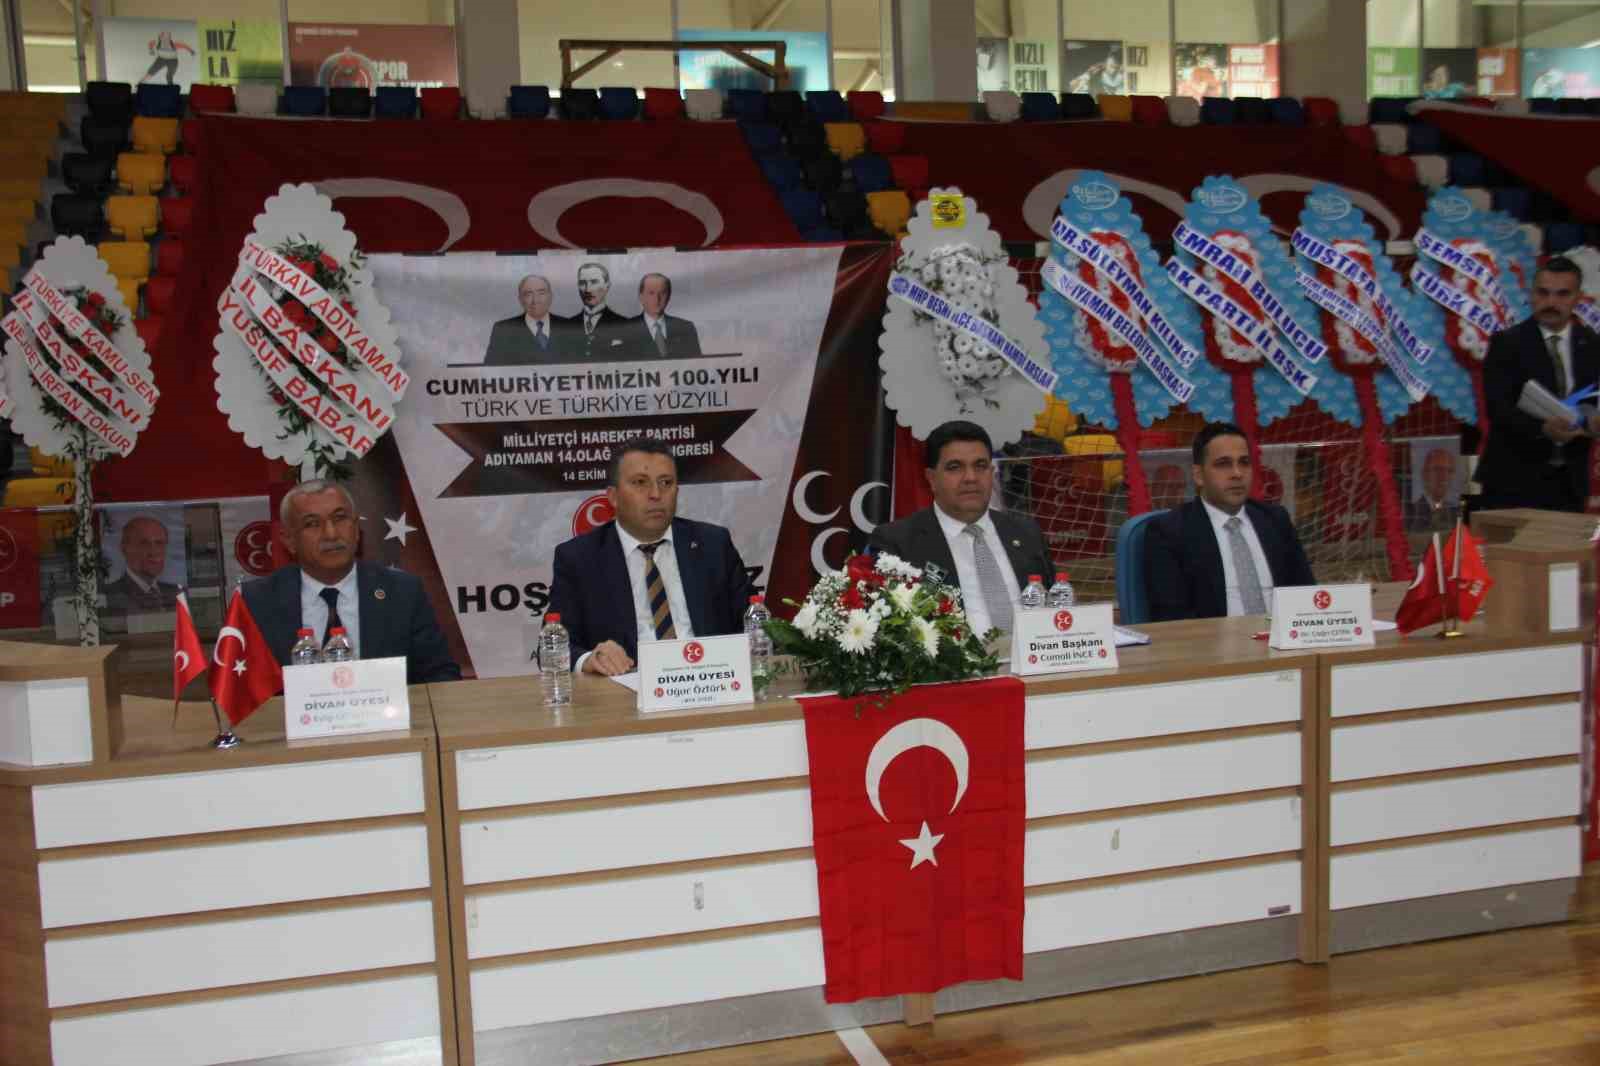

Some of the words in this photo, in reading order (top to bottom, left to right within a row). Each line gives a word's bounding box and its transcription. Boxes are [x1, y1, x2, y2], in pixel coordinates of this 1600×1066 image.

[1166, 259, 1195, 288] AK
[310, 297, 408, 393] ADIYAMAN
[36, 321, 142, 424] BAŞKANI
[83, 328, 157, 405] KAMU-SEN
[221, 294, 287, 376] YUSUF
[285, 376, 374, 454] BABAR
[262, 305, 392, 430] BAŞKANI
[426, 369, 661, 396] CUMHURİYETİMİZİN
[670, 366, 759, 387] 100.YILI
[461, 398, 515, 419] TÜRK
[524, 397, 552, 416] VE
[560, 392, 648, 415] TÜRKİYE
[652, 390, 729, 410] YÜZYILI
[82, 407, 131, 451] TOKUR
[503, 429, 579, 449] MİLLİYETÇİ
[646, 424, 695, 440] PARTİSİ
[484, 448, 553, 467] ADIYAMAN
[557, 446, 612, 464] 14.OLAĞ
[562, 471, 575, 481] 14
[578, 469, 607, 481] EKİM
[1030, 640, 1059, 652] Divan
[657, 673, 695, 685] DİVAN
[698, 670, 735, 682] ÜYESİ
[304, 699, 346, 711] DİVAN
